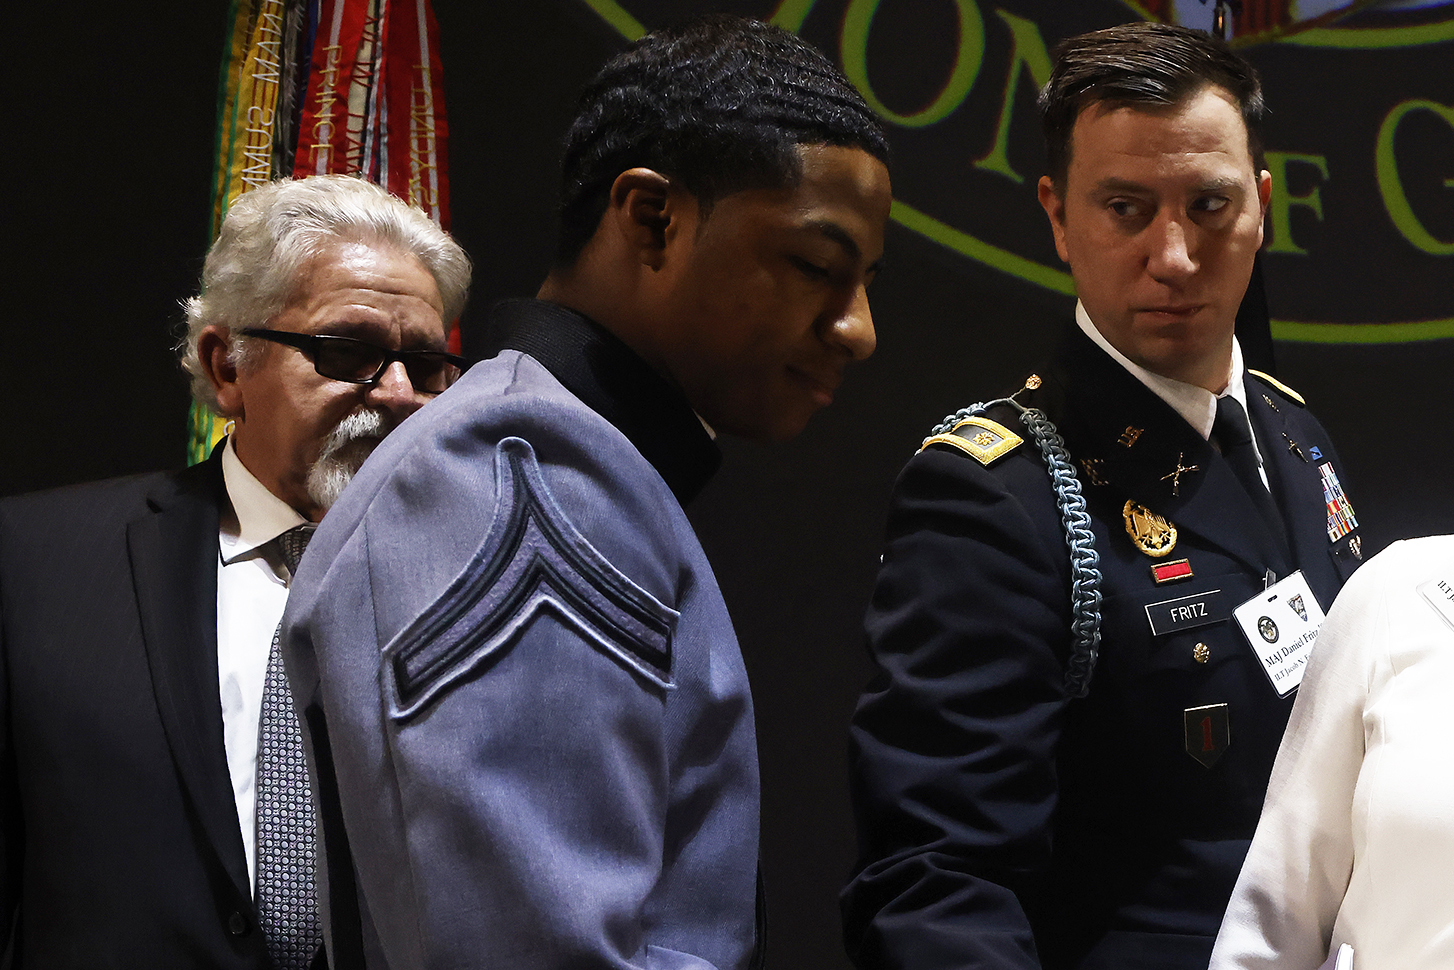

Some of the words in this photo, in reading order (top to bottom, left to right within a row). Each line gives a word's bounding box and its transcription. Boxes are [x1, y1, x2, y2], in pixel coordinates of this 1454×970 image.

[309, 45, 342, 176] PRINCE
[1170, 602, 1208, 623] FRITZ
[1265, 651, 1283, 668] MAJ
[1281, 637, 1305, 657] Daniel
[1284, 662, 1299, 677] Jacob
